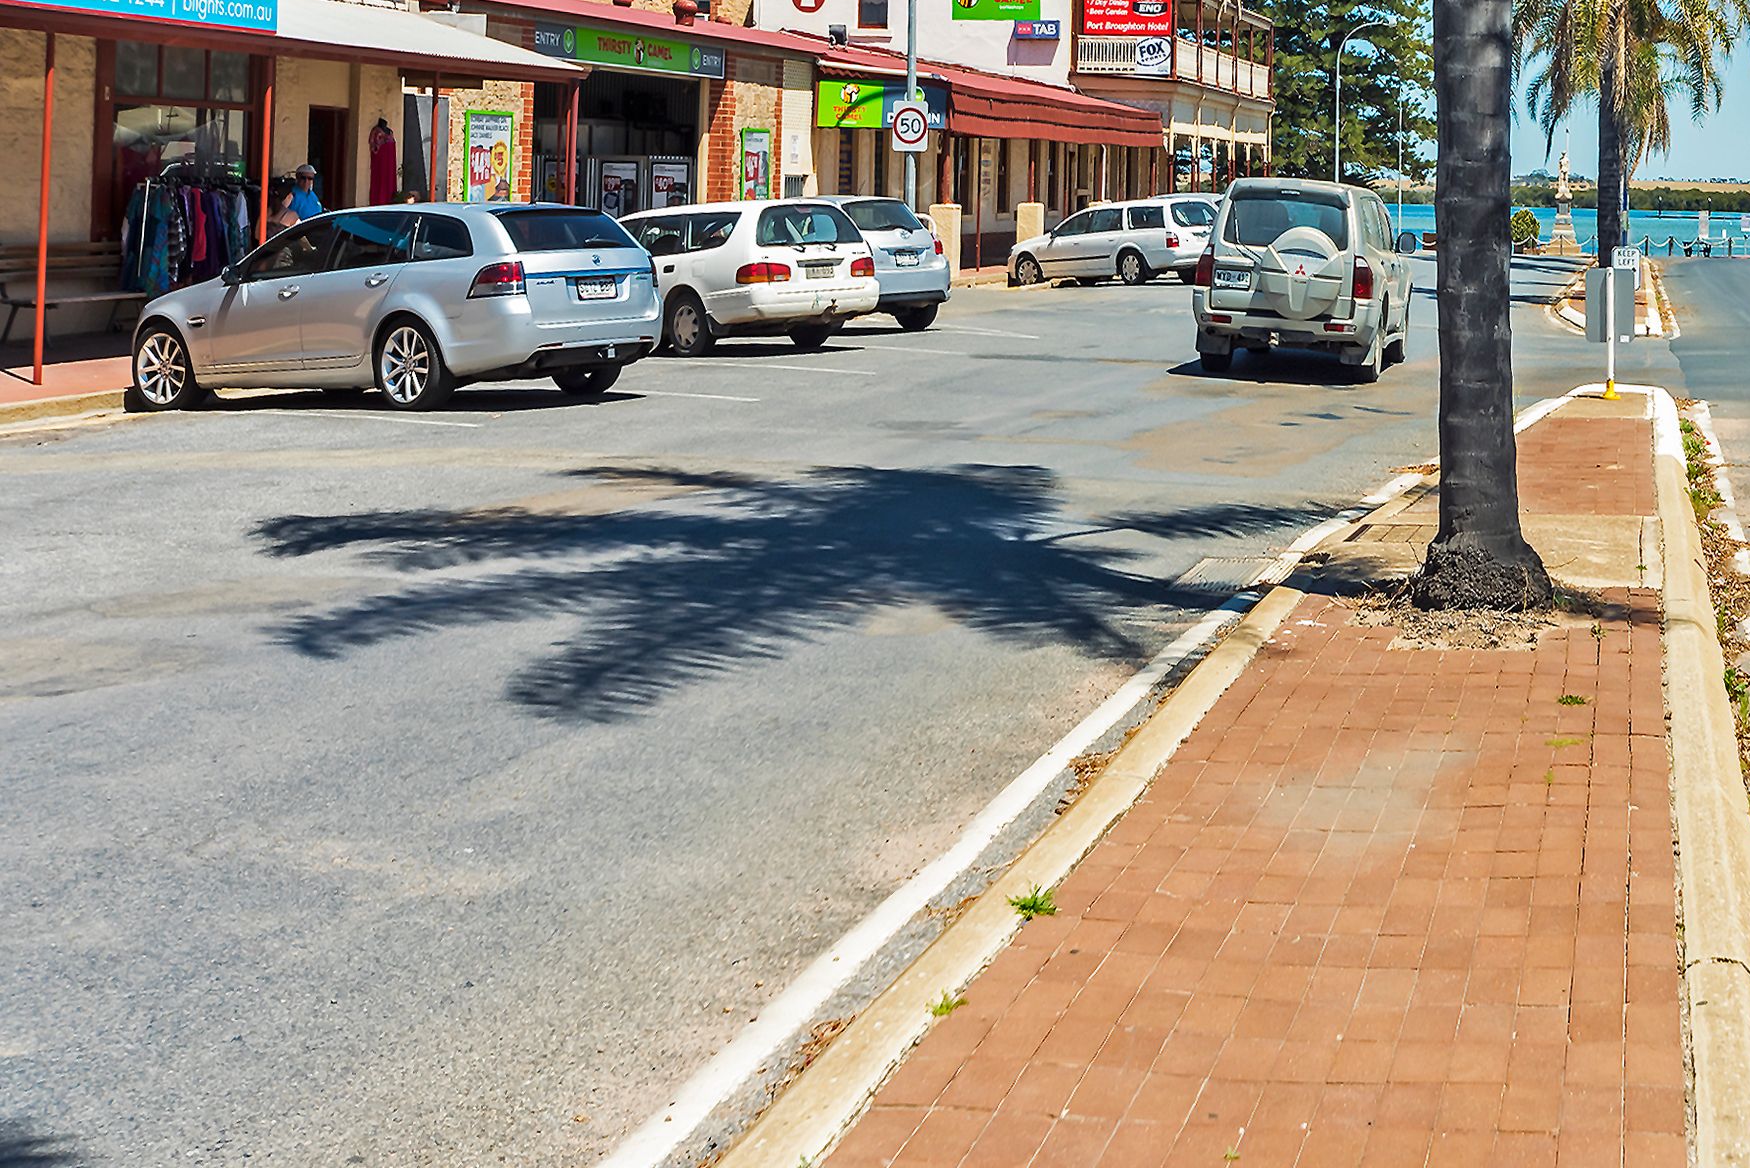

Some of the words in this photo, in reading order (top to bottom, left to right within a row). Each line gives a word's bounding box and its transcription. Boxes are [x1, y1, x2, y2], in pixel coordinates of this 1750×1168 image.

[1138, 4, 1162, 13] END
[1033, 23, 1057, 35] TAB
[1086, 21, 1104, 30] Port
[1105, 22, 1146, 32] Broughton
[1147, 22, 1169, 31] Hotel
[535, 31, 561, 47] ENTRY
[597, 37, 631, 55] THIRSTY
[647, 43, 673, 61] CAMEL
[1138, 40, 1165, 58] FOX
[702, 53, 722, 66] ENTRY
[900, 117, 921, 134] 50
[1618, 258, 1635, 266] LEFT
